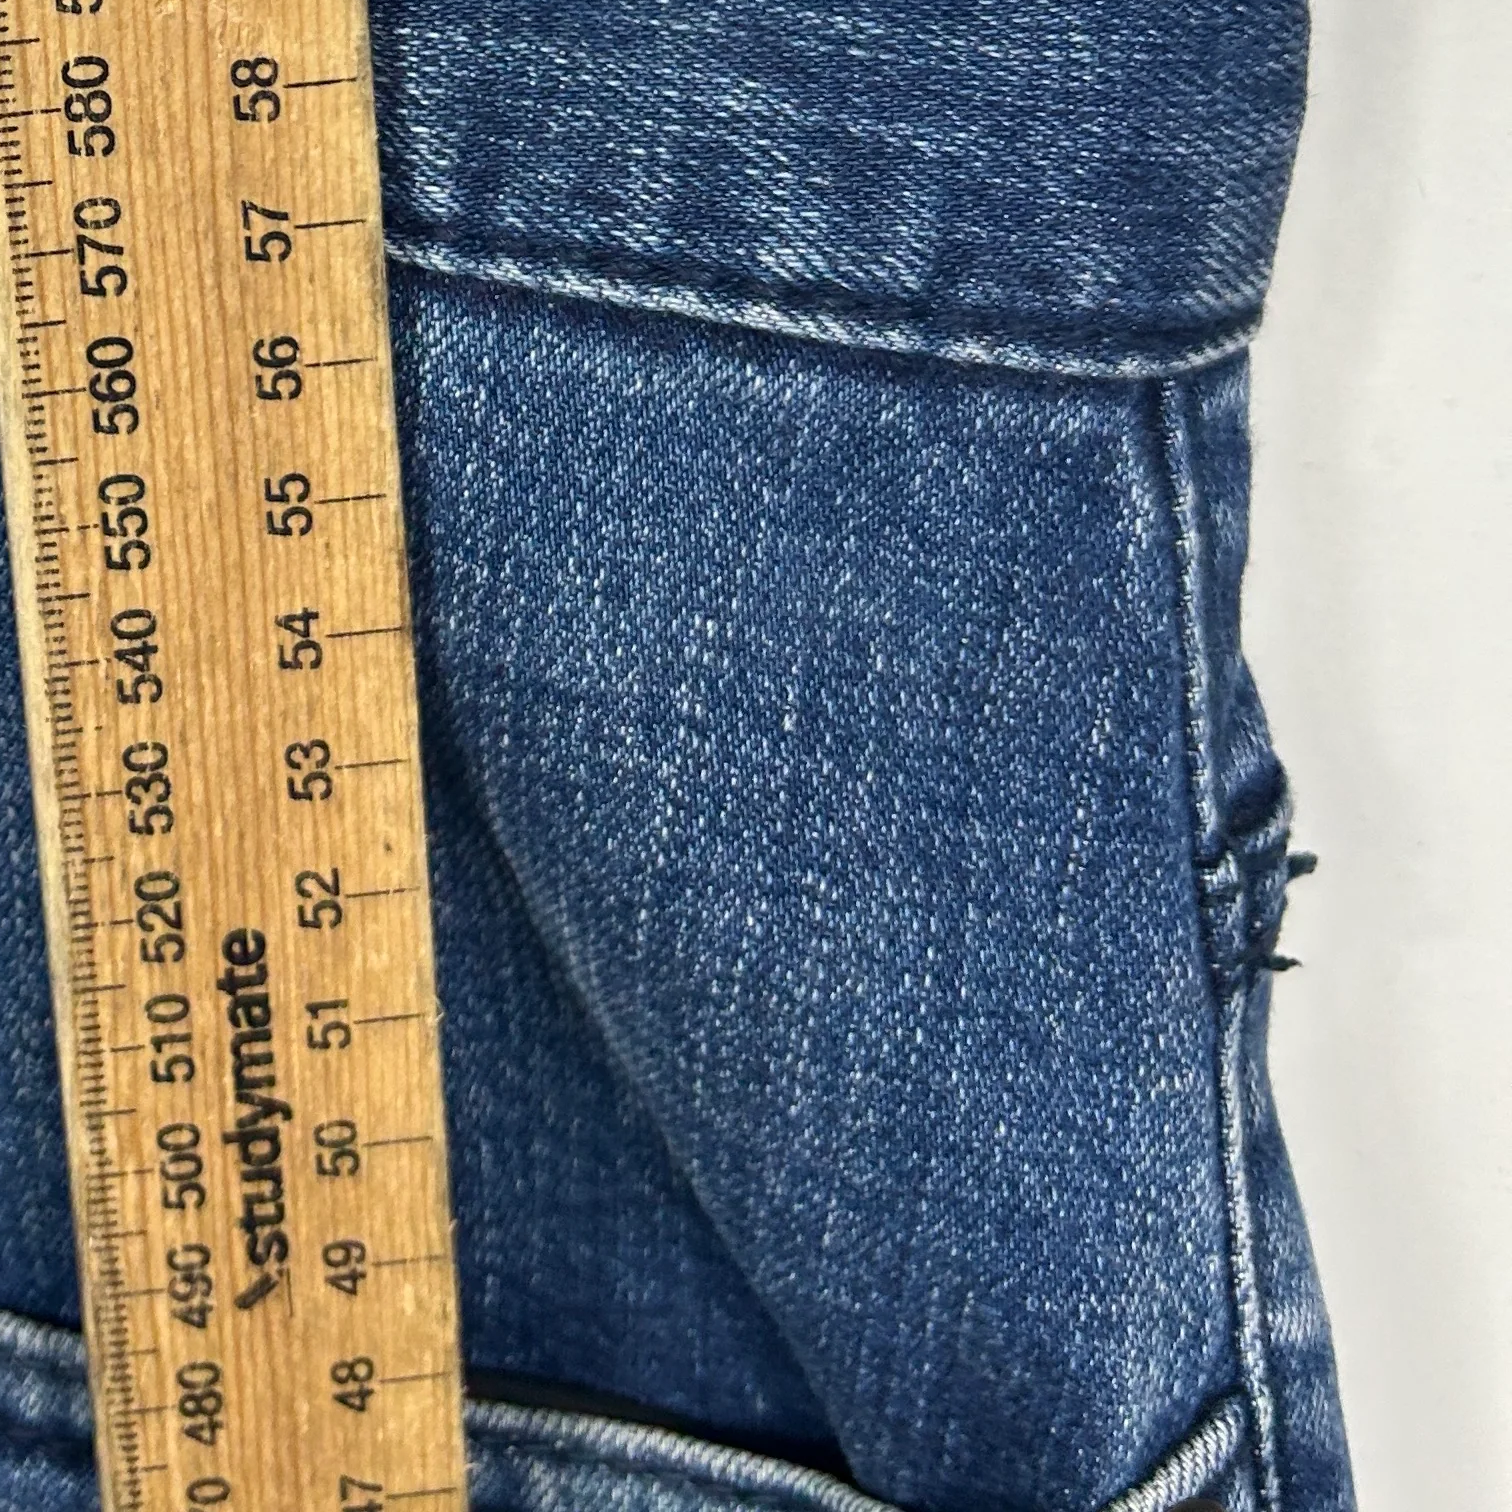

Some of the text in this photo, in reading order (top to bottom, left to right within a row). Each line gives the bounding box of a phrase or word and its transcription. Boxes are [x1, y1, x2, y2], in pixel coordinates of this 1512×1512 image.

[61, 56, 115, 157] 580
[231, 57, 280, 122] 58
[74, 198, 127, 298] 570
[242, 200, 292, 262] 57
[86, 337, 139, 434] 560
[253, 336, 302, 400] 56
[98, 474, 151, 571] 550
[264, 473, 313, 536] 55
[110, 609, 162, 704] 540
[275, 608, 322, 670] 54
[122, 743, 174, 835] 530
[285, 740, 332, 801] 53
[134, 871, 185, 963] 520
[295, 868, 342, 929] 52
[145, 994, 195, 1084] 510
[305, 1000, 351, 1050] 51
[216, 928, 292, 1265] studymate
[157, 1124, 206, 1211] 500
[314, 1120, 360, 1177] 50
[167, 1244, 213, 1329] 490
[322, 1240, 366, 1296] 49
[176, 1363, 223, 1446] 480
[331, 1358, 374, 1413] 48
[186, 1477, 230, 1512] 0
